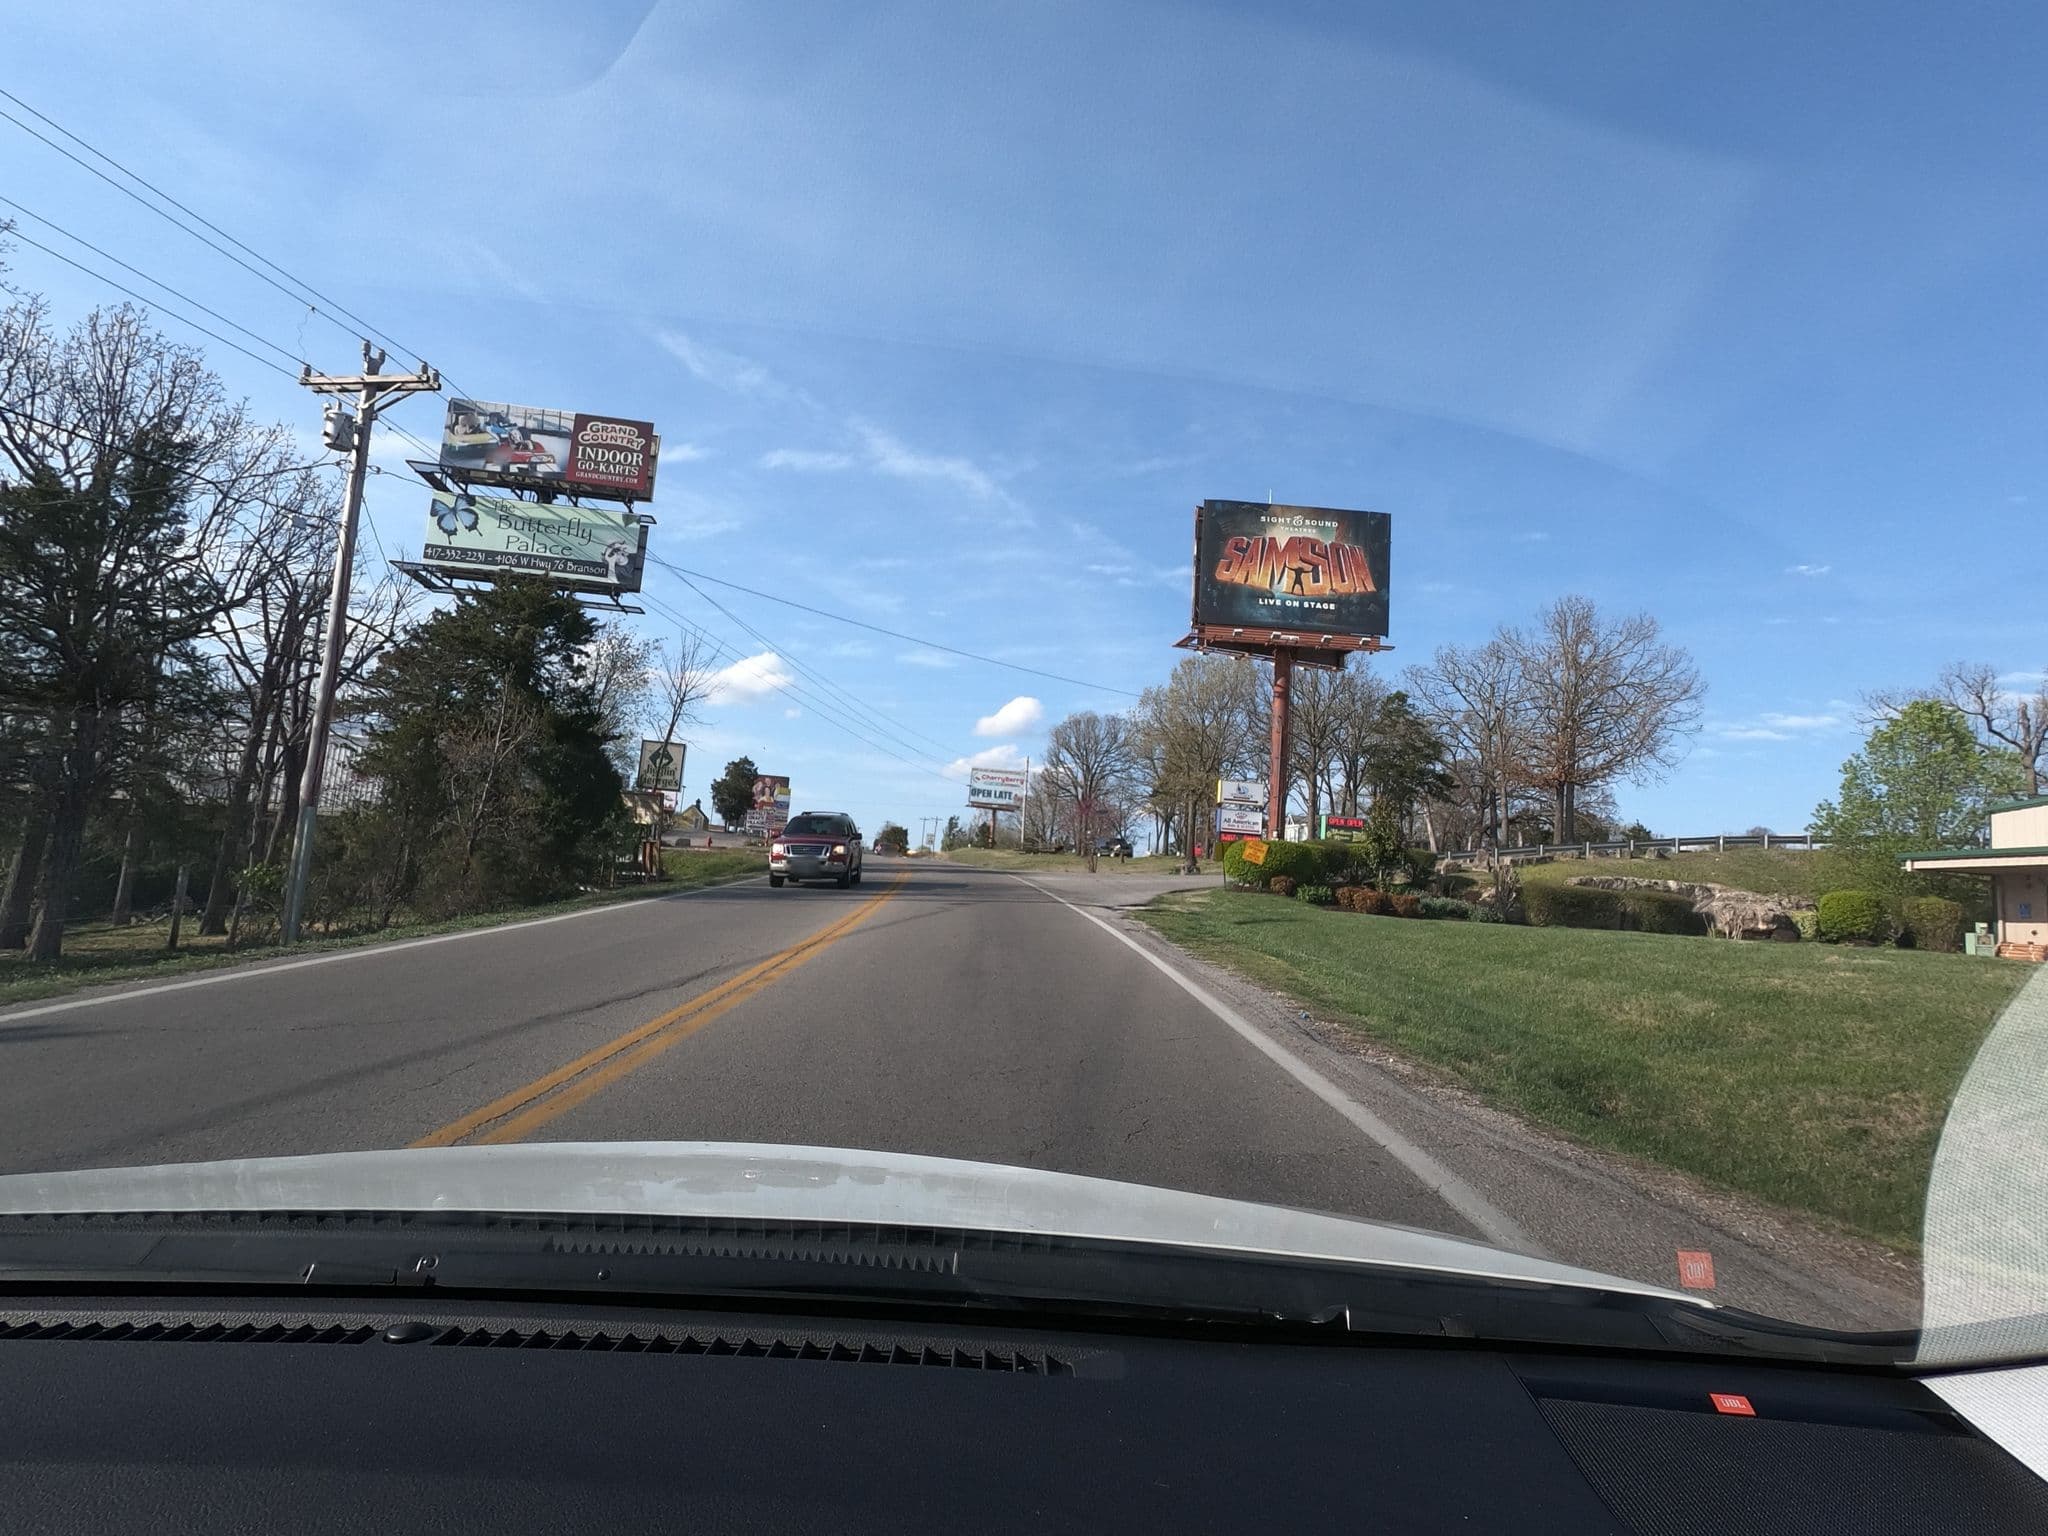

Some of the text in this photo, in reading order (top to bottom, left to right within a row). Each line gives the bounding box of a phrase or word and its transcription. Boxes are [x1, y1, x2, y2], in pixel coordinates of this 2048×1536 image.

[588, 422, 638, 438] GRAND
[579, 431, 645, 450] COUNTRY
[576, 445, 644, 466] INDOOR
[577, 460, 639, 476] GO-KARTS
[575, 471, 639, 484] GRANDCOUNTRY.COM
[493, 500, 516, 513] The
[1260, 515, 1292, 524] SIGHT
[1305, 519, 1339, 528] SOUND
[497, 514, 593, 546] Butterfly
[506, 533, 573, 556] Palace
[425, 546, 485, 563] 417-332-2231
[495, 555, 518, 565] 4106
[520, 556, 529, 565] W
[531, 558, 551, 569] Hwy
[552, 559, 564, 571] 76
[567, 562, 607, 576] Branson
[1215, 536, 1378, 597] SAMSON
[1259, 598, 1336, 611] LIVE ON STAGE
[971, 788, 992, 798] OPEN
[994, 790, 1012, 800] LATE
